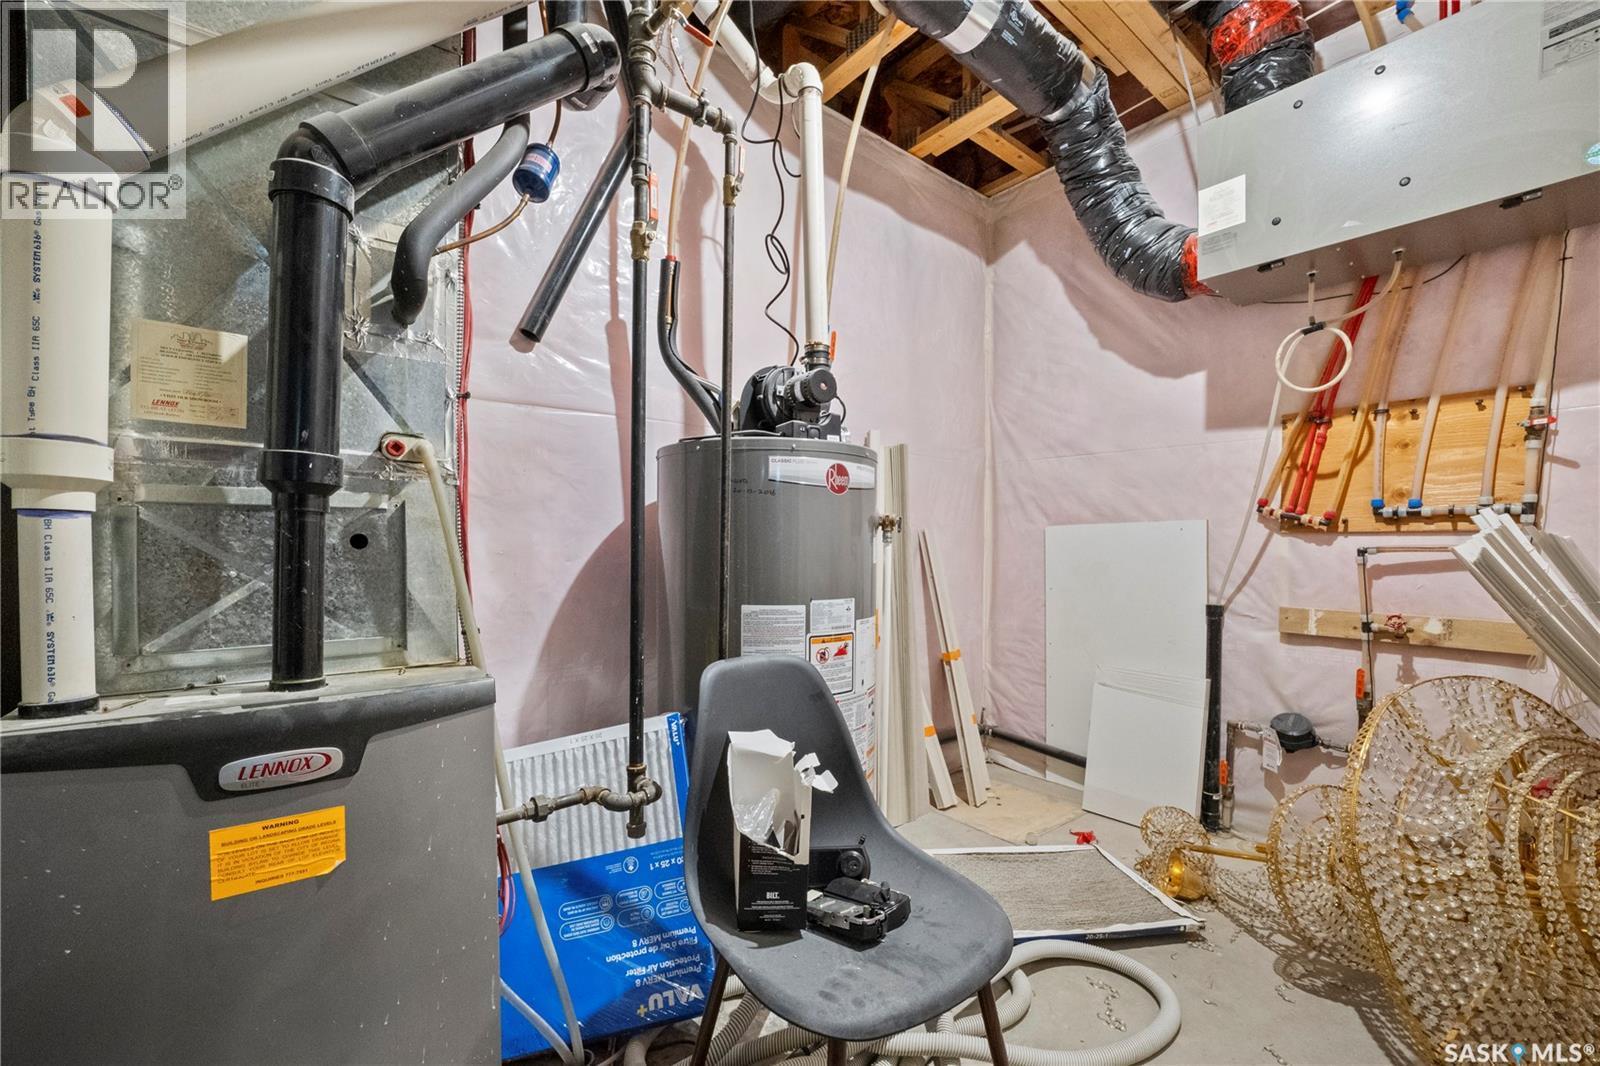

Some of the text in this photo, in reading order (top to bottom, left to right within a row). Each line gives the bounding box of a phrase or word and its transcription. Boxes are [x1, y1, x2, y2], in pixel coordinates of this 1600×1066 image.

[31, 356, 40, 382] Class
[151, 399, 180, 408] LENNOX
[43, 534, 53, 562] Class
[237, 755, 314, 781] LENNOX
[262, 819, 300, 831] WARNING
[660, 861, 670, 869] 25
[632, 926, 697, 947] Premium MERV 8
[678, 936, 698, 946] Filtre
[605, 947, 647, 962] protection
[648, 945, 659, 954] de
[625, 954, 700, 977] Protection Air Filter
[635, 965, 702, 987] Premium MERV 8
